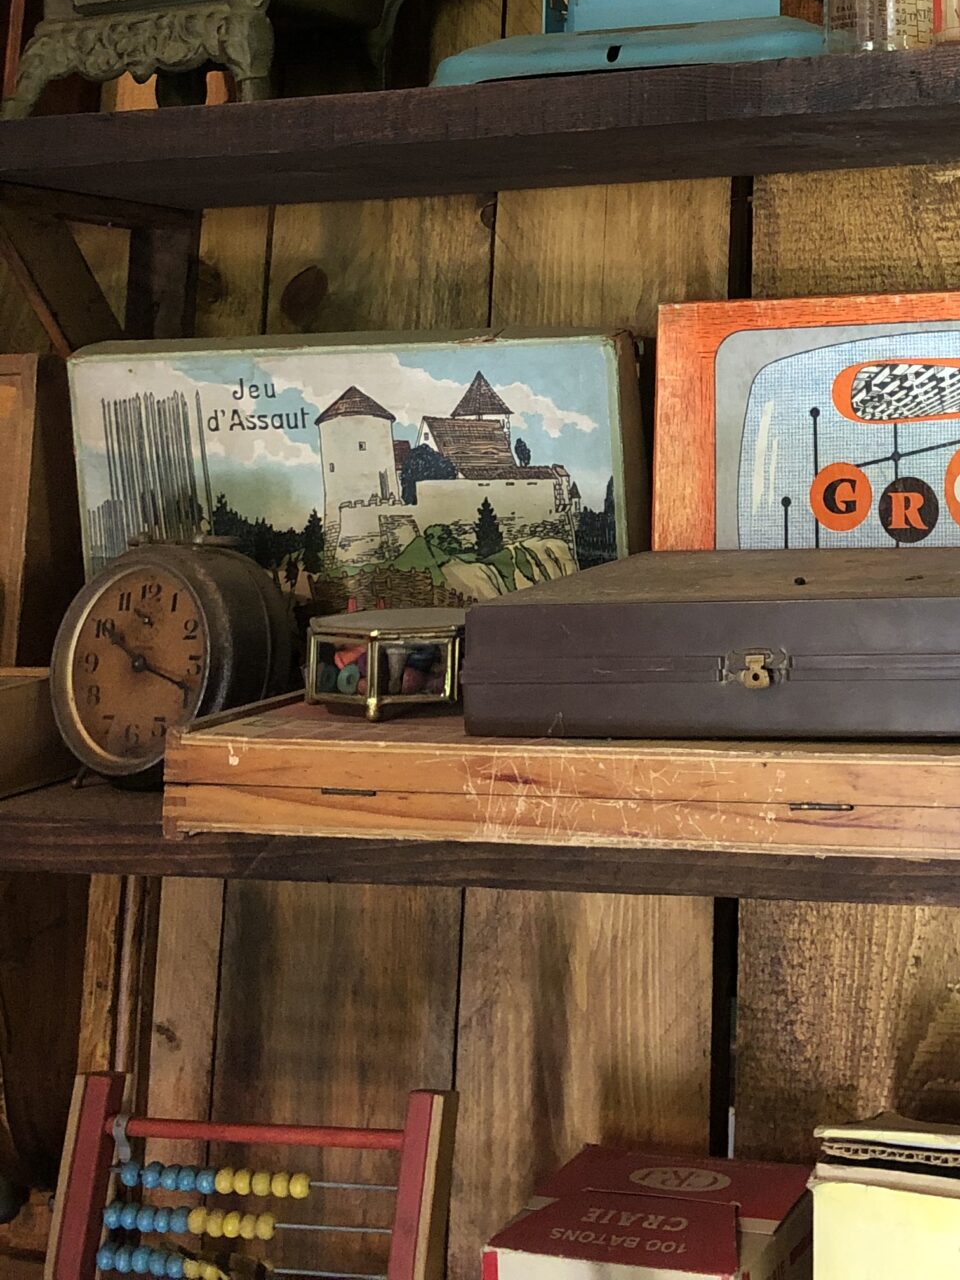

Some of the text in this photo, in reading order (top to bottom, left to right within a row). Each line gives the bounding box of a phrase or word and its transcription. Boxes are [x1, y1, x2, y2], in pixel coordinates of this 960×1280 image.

[232, 376, 277, 401] Jeu
[207, 406, 309, 433] d'Assaut
[118, 592, 131, 611] 11
[141, 583, 162, 602] 12
[170, 592, 178, 612] 1
[95, 619, 115, 638] 10
[182, 619, 198, 640] 2
[85, 652, 99, 674] 9
[187, 655, 202, 676] 3
[86, 685, 100, 705] 8
[103, 714, 115, 735] 7
[125, 723, 140, 745] 6
[152, 716, 166, 737] 5
[581, 1208, 689, 1232] CRAIE
[647, 1240, 688, 1254] 100
